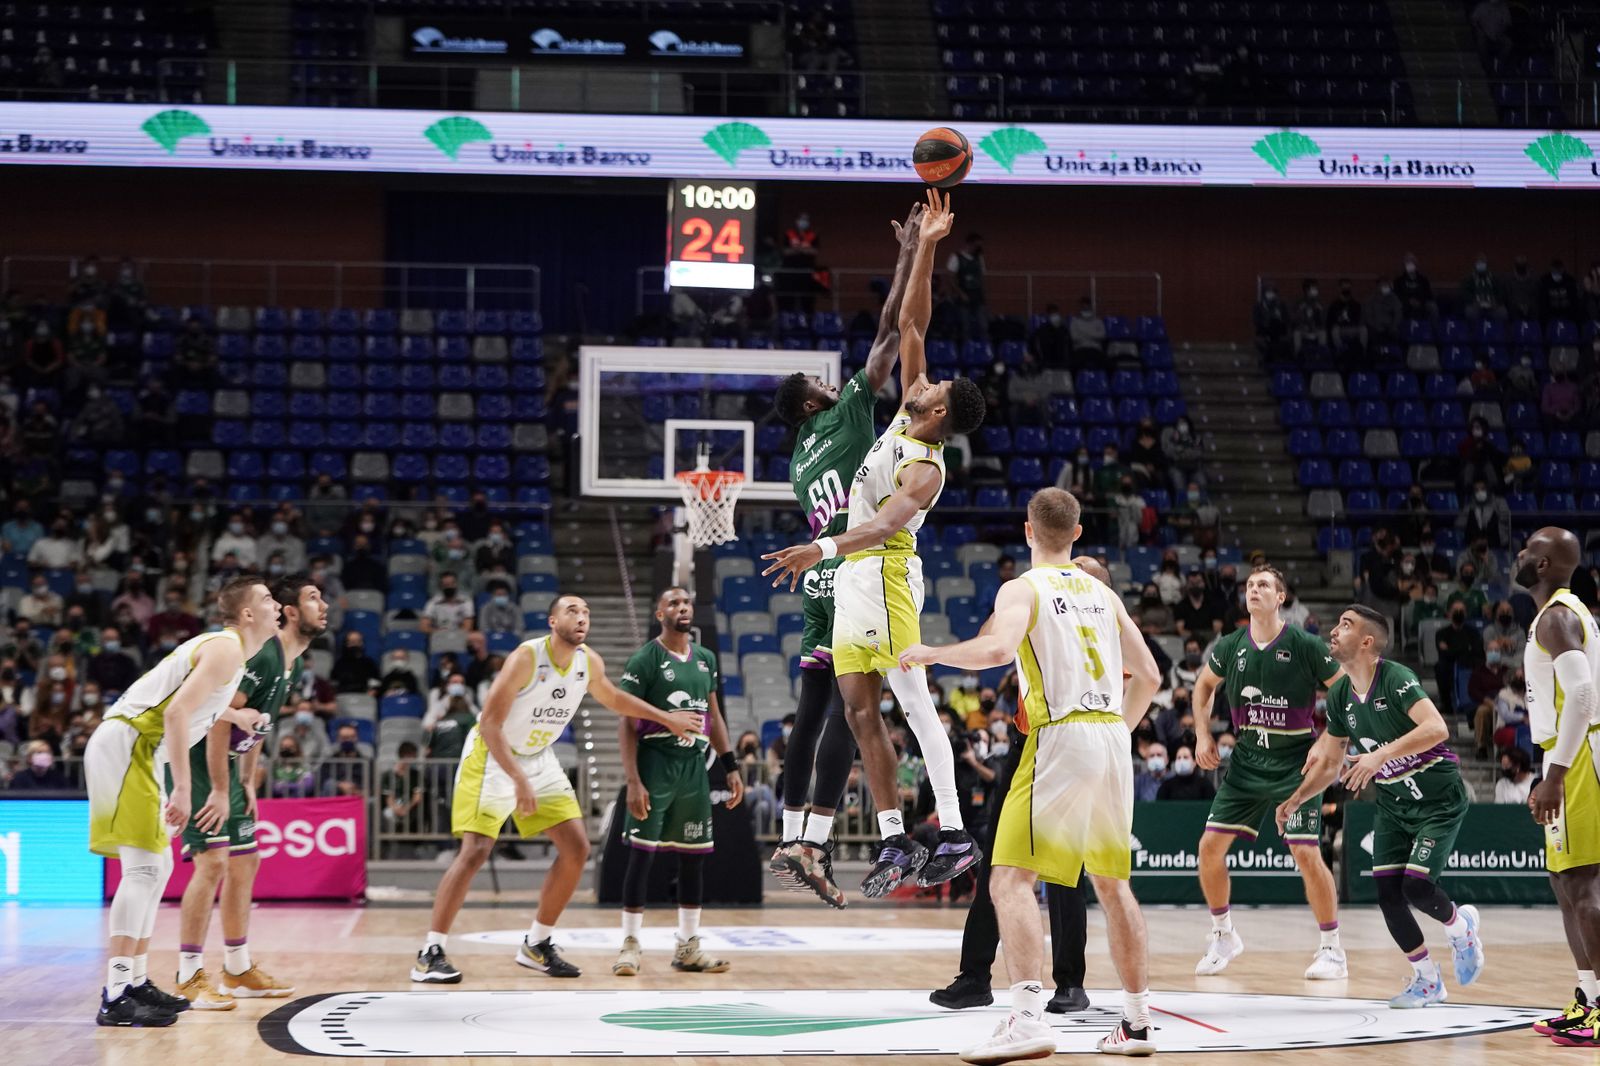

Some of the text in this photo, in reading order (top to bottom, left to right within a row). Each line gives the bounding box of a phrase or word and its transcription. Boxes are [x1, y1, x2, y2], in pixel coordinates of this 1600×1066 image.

[18, 133, 88, 154] Banco
[208, 136, 372, 161] Unicaja Banco
[489, 142, 652, 166] Unicaja Banco
[769, 148, 855, 171] Unicaja
[859, 151, 913, 170] Banc
[1044, 150, 1202, 176] Unicaja Banco
[1318, 153, 1475, 181] Unicaja Banco
[681, 185, 755, 210] 10:00
[681, 217, 745, 263] 24
[808, 469, 847, 528] 50
[1076, 625, 1105, 682] 5
[532, 706, 571, 718] urbas
[1403, 776, 1424, 801] 3
